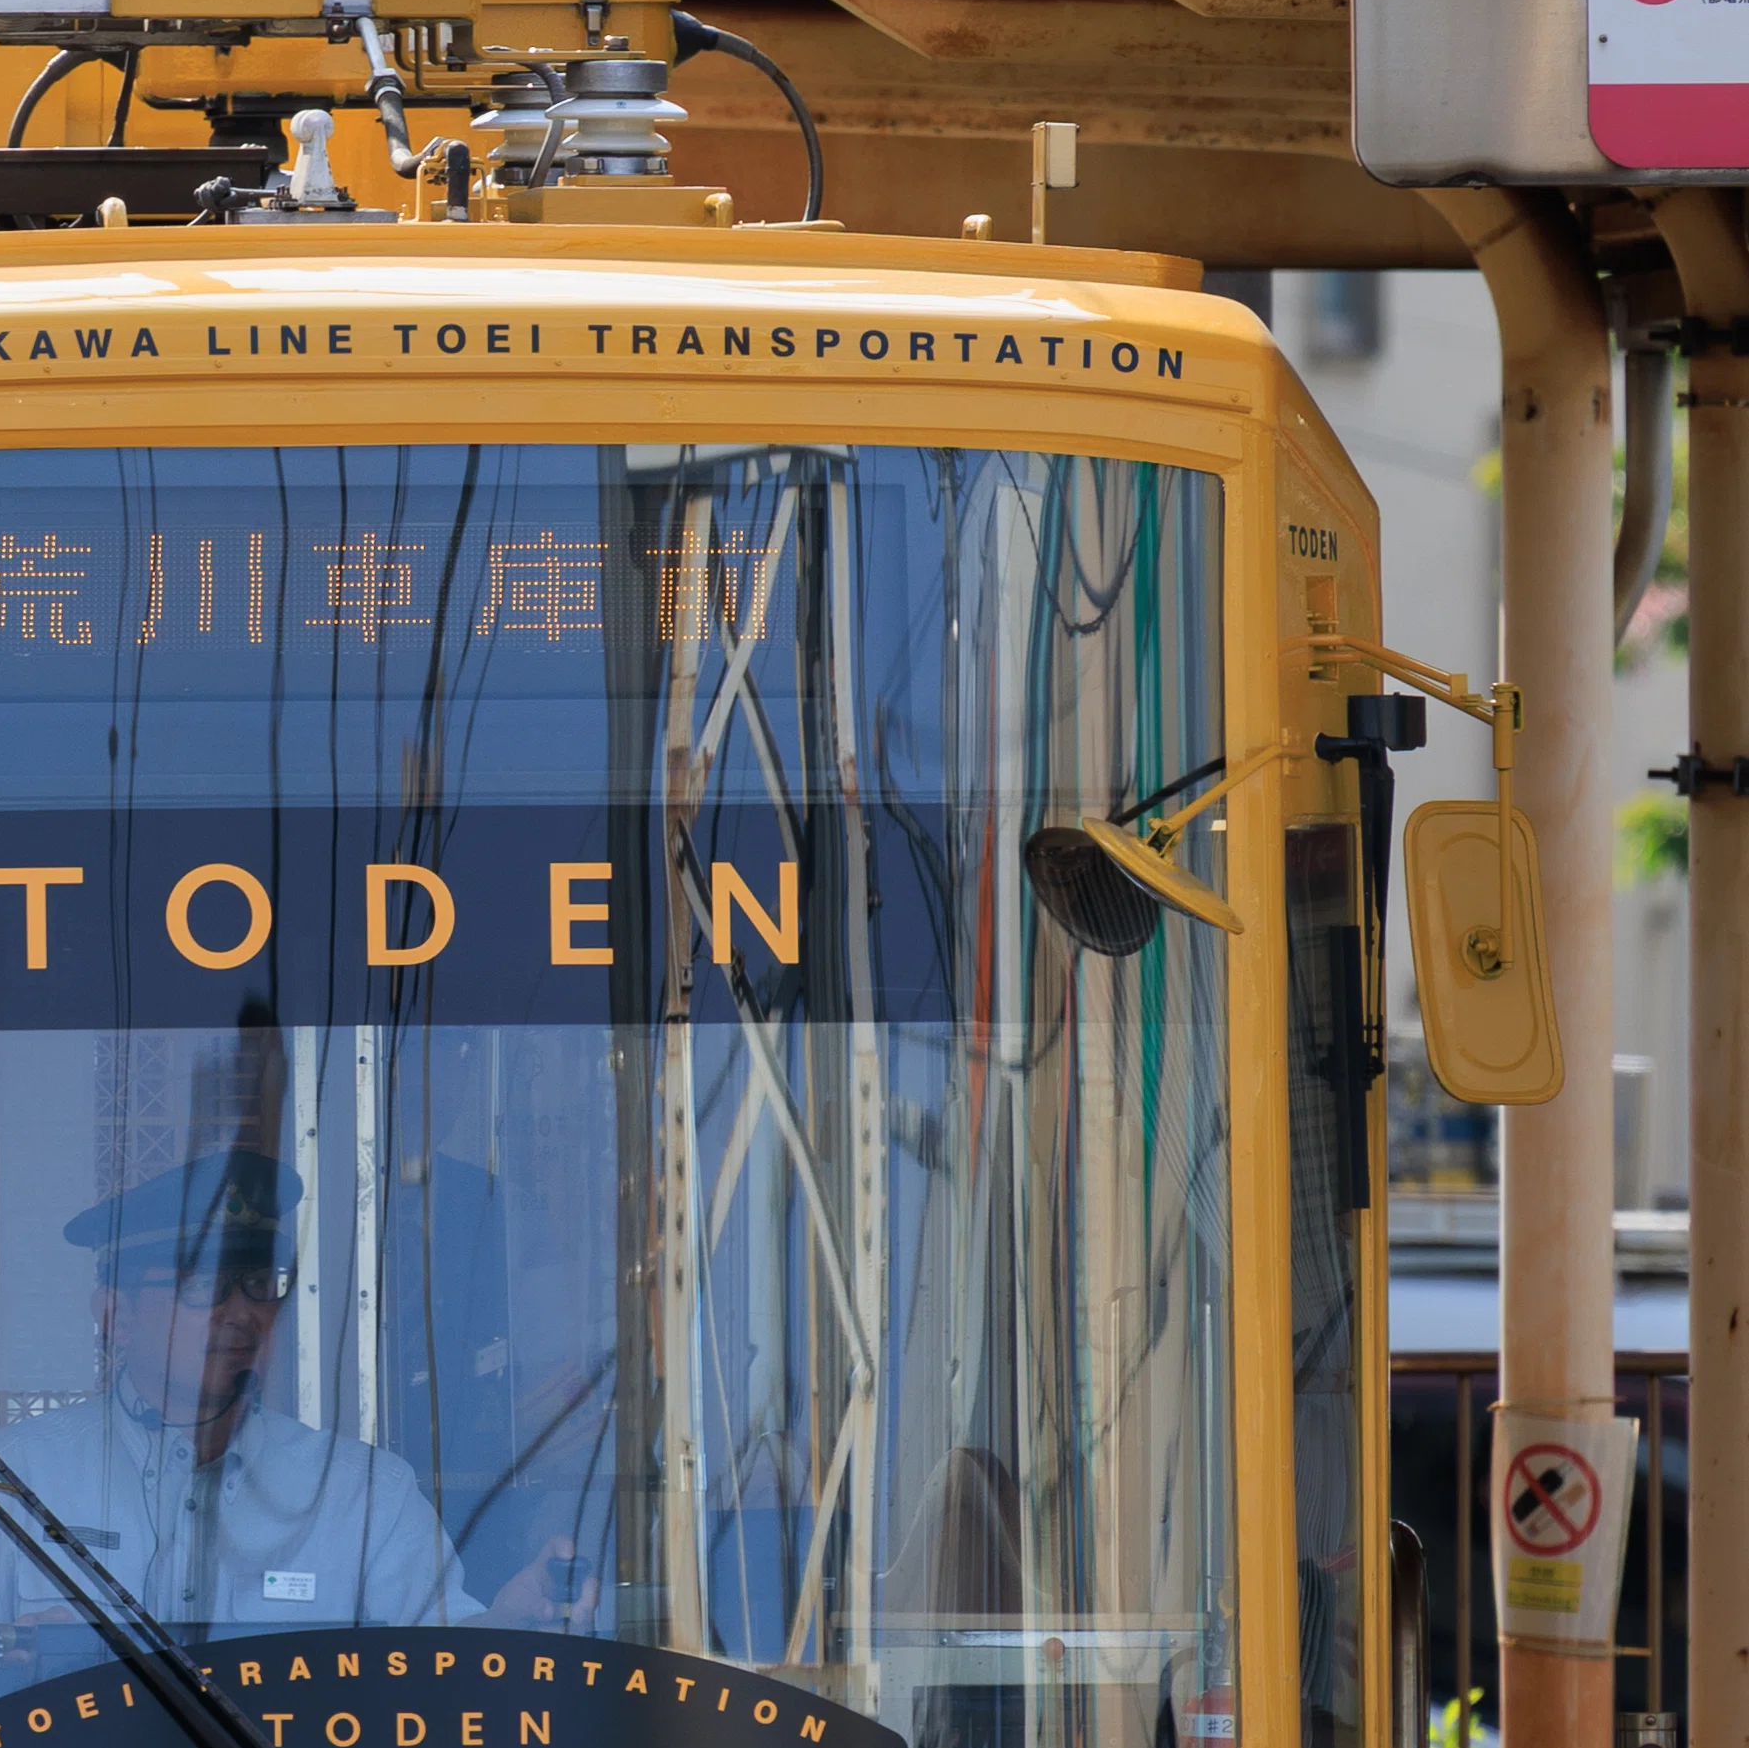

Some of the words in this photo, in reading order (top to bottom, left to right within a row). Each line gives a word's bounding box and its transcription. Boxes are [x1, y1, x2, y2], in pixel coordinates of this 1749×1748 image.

[206, 324, 353, 356] LINE
[394, 323, 541, 354] TOEI
[593, 324, 1184, 380] TRANSPORTATION
[1288, 524, 1338, 562] TODEN
[262, 1710, 553, 1748] TODEN
